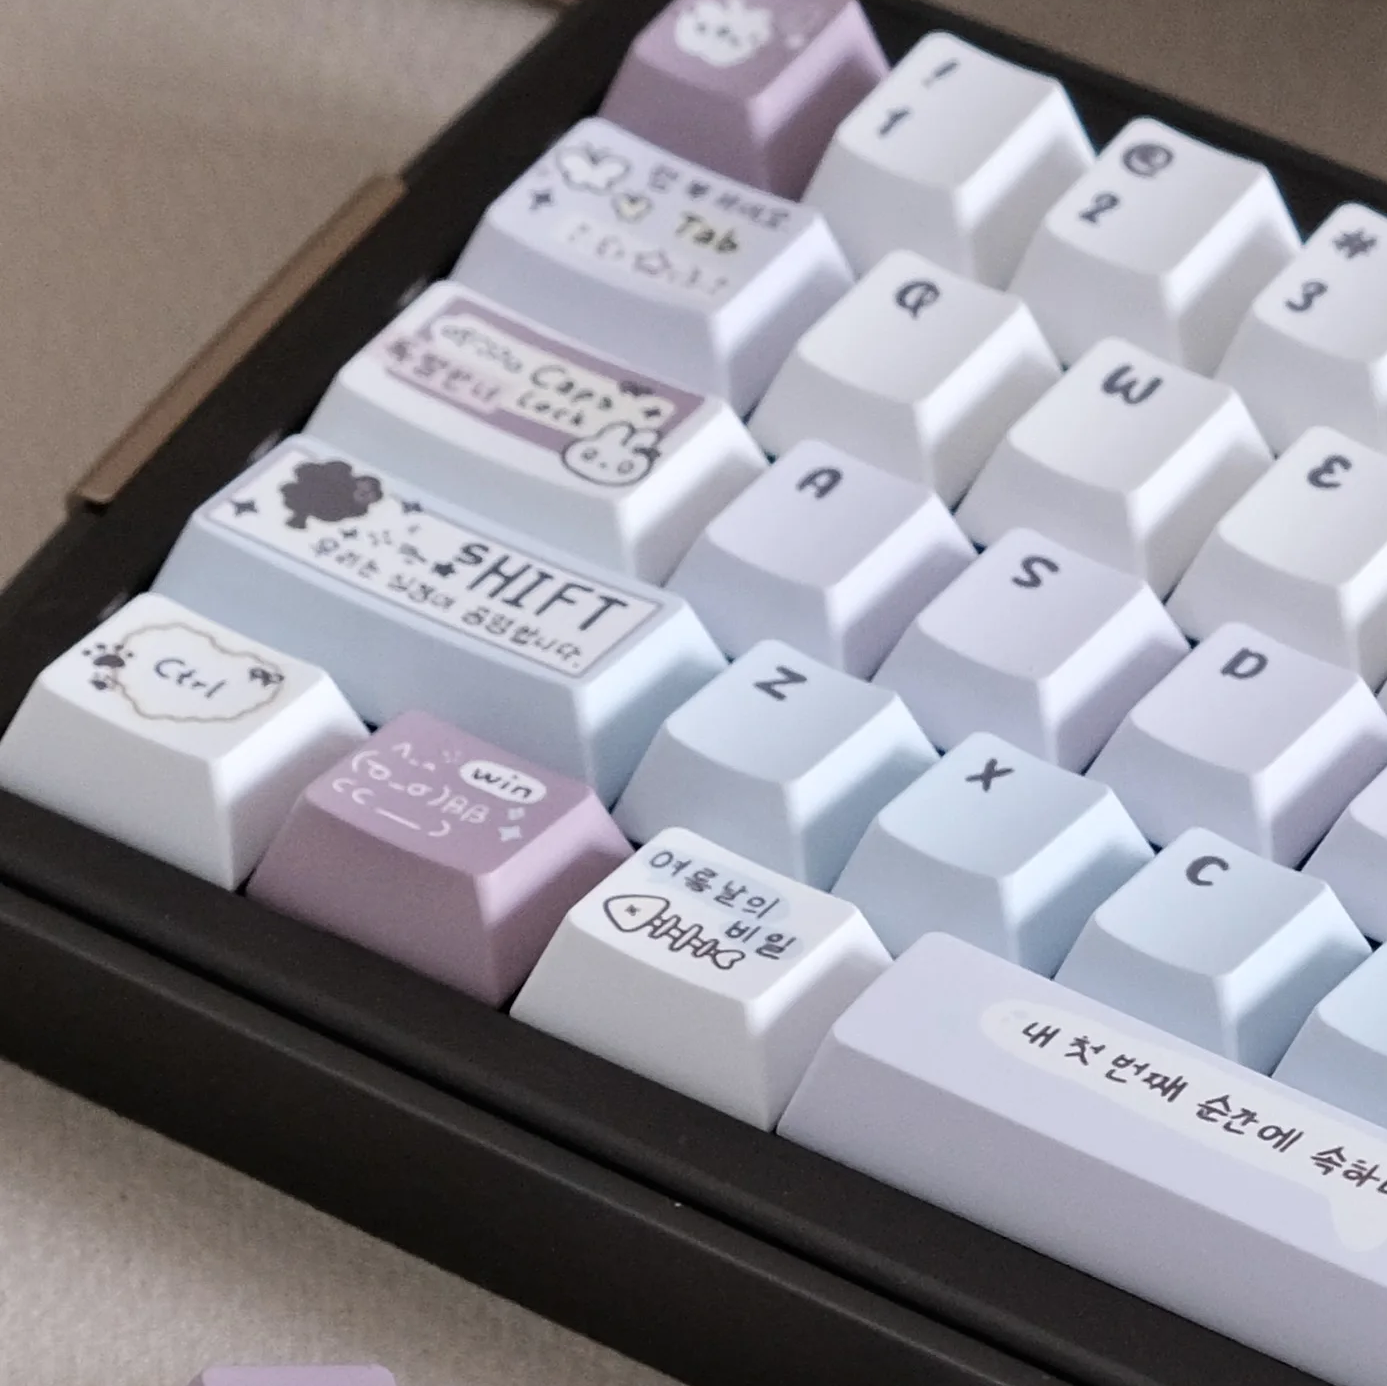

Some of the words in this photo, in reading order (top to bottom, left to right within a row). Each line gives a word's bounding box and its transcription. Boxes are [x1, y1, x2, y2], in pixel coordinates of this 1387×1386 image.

[1079, 193, 1120, 224] 2
[674, 210, 740, 256] Tab
[1333, 231, 1377, 259] #
[895, 281, 940, 318] Q
[1286, 281, 1328, 313] 3
[529, 362, 614, 414] Caps
[1102, 365, 1163, 405] W
[797, 468, 843, 499] A
[1307, 455, 1352, 489] E
[453, 540, 628, 635] SHIFT
[1012, 556, 1059, 589] S
[154, 658, 227, 701] Ctrl
[1220, 648, 1268, 679] D
[754, 666, 807, 701] Z
[470, 766, 533, 802] win
[966, 759, 1014, 792] X
[649, 849, 780, 921] 여름날의
[1186, 856, 1229, 886] C
[1022, 1021, 1061, 1049] 내
[1064, 1034, 1107, 1066] 첫
[1104, 1053, 1189, 1104] 번째
[1197, 1094, 1304, 1154] 순간에
